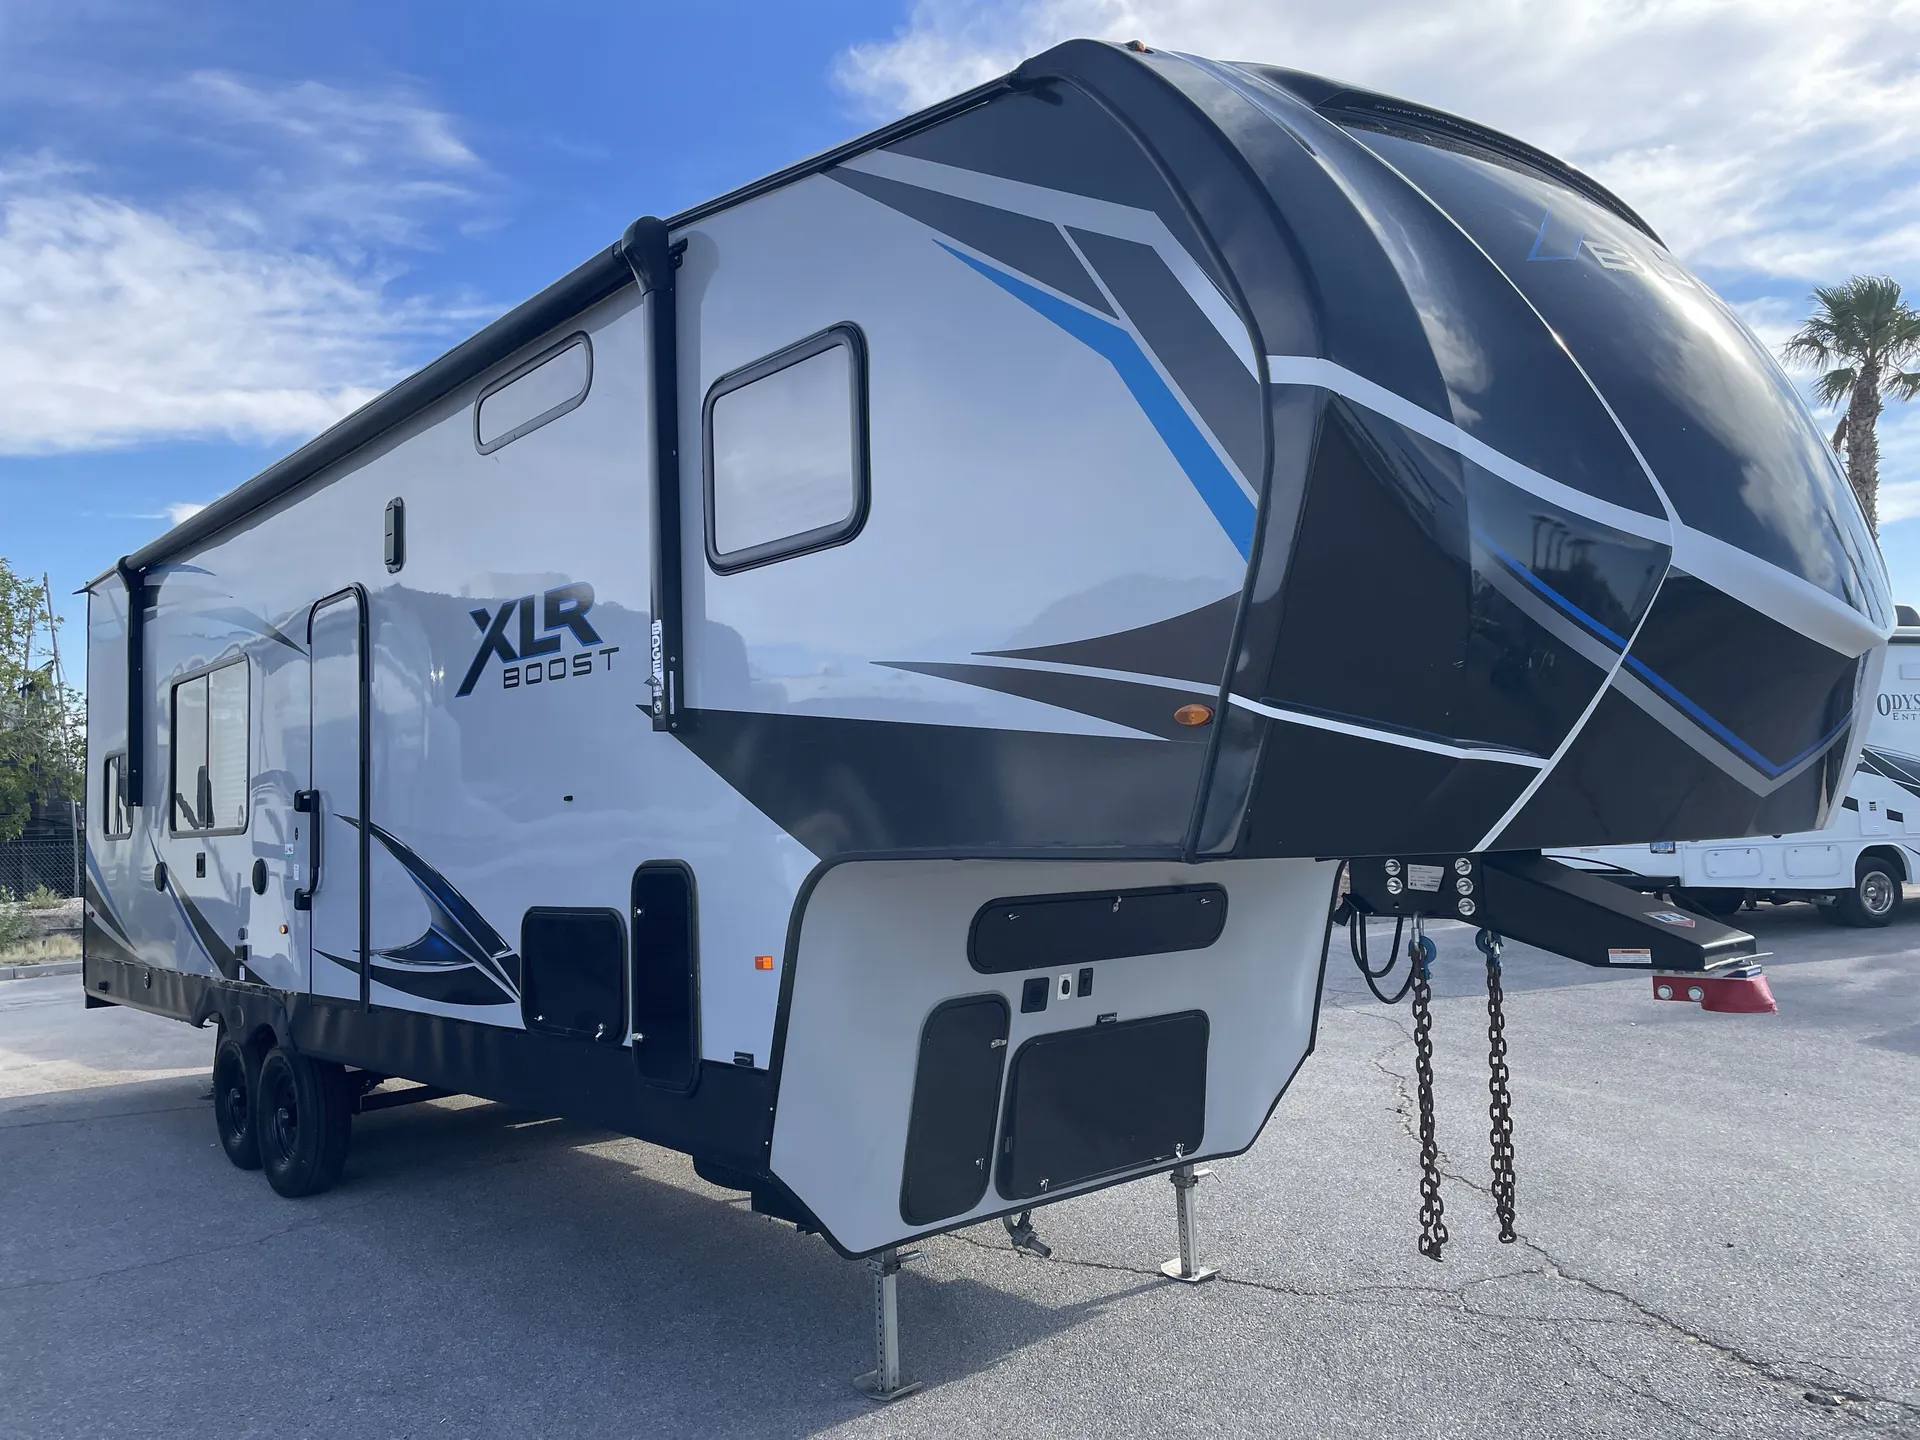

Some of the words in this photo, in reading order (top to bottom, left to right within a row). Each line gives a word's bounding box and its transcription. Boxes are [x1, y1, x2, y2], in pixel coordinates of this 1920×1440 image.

[455, 581, 604, 698] XLR
[503, 646, 619, 689] BOOST
[1892, 712, 1920, 721] ENT
